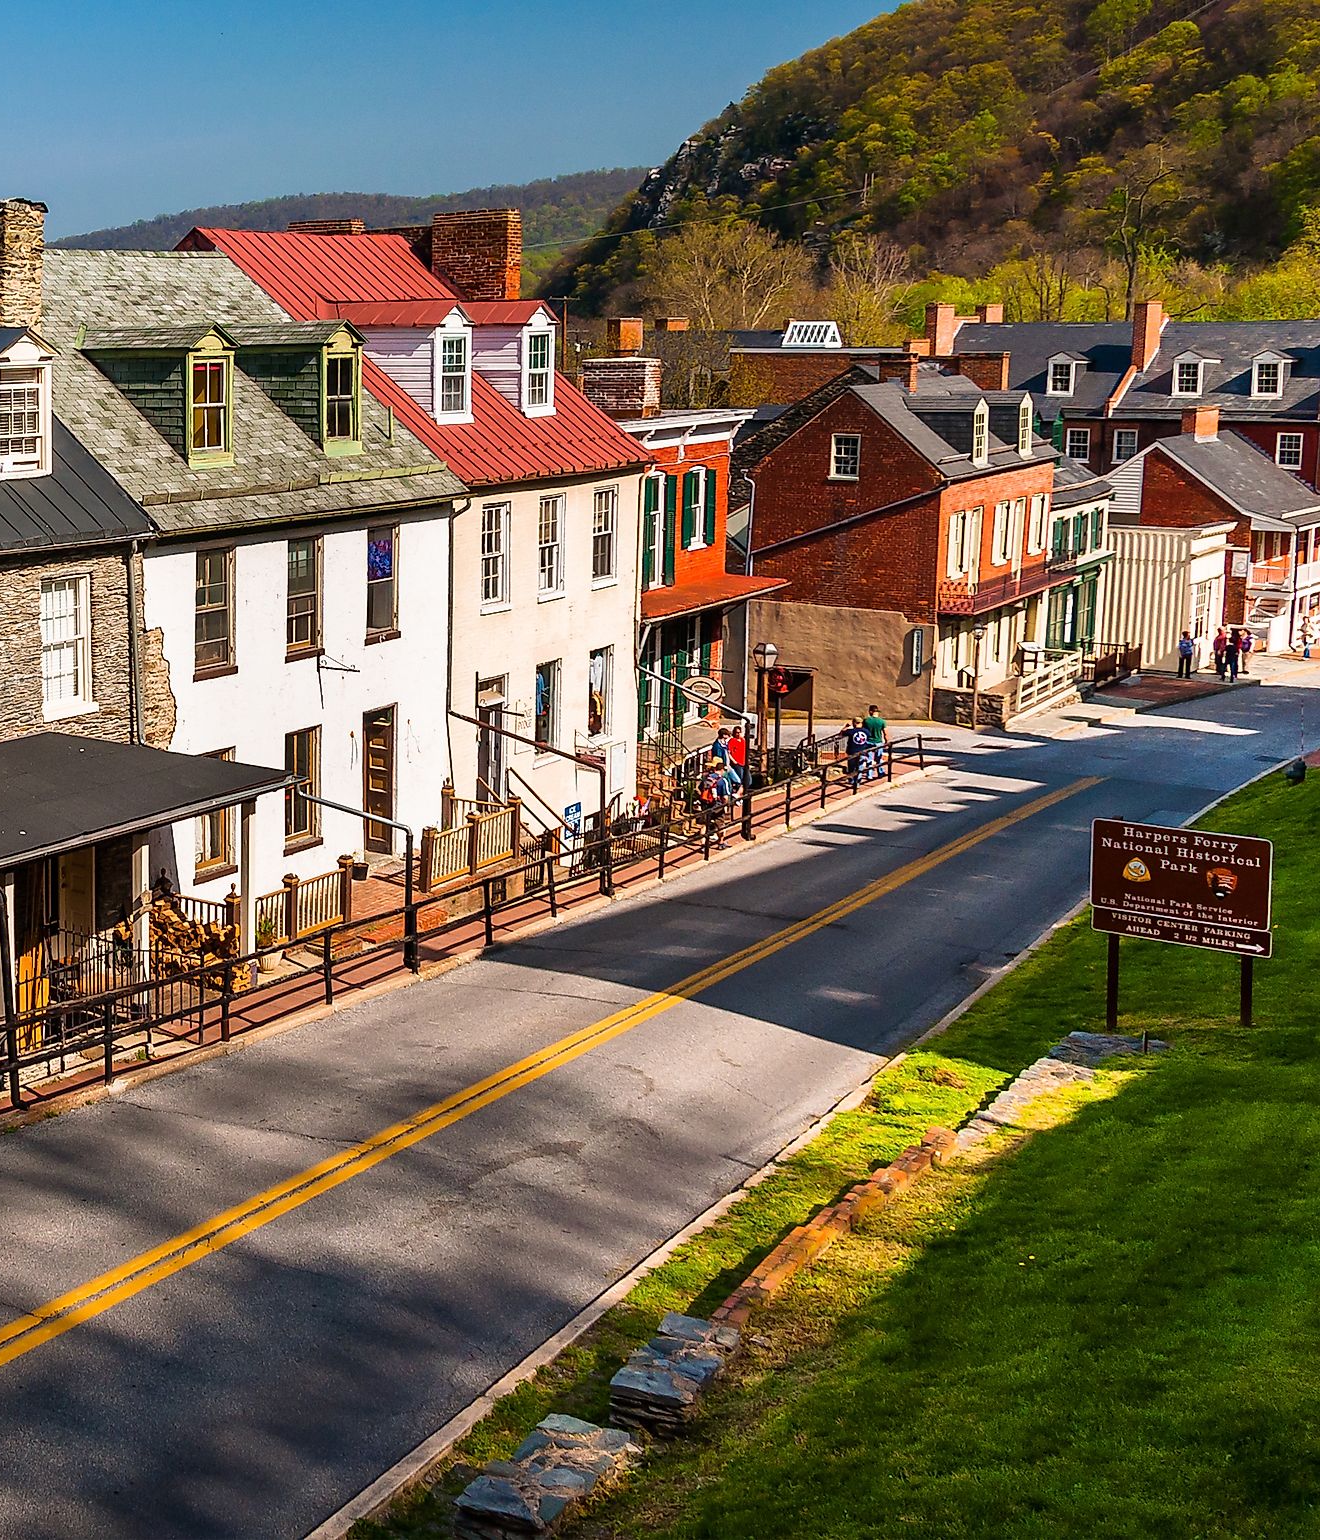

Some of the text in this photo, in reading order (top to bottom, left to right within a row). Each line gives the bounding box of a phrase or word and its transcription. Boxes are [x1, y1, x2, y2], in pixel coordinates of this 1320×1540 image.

[1101, 837, 1261, 868] National Historical
[1123, 826, 1239, 853] Harpers Ferry
[1160, 859, 1199, 874] Park
[1100, 897, 1119, 906] U.S.
[1122, 901, 1179, 915] Department
[1197, 912, 1213, 920] the
[1218, 915, 1259, 926] Interior
[1124, 893, 1233, 915] National Park Service
[1111, 912, 1251, 940] VISITOR CENTER PARKING
[1126, 924, 1161, 936] AHEAD
[1185, 934, 1198, 942] 1/2
[1202, 936, 1235, 948] MILES
